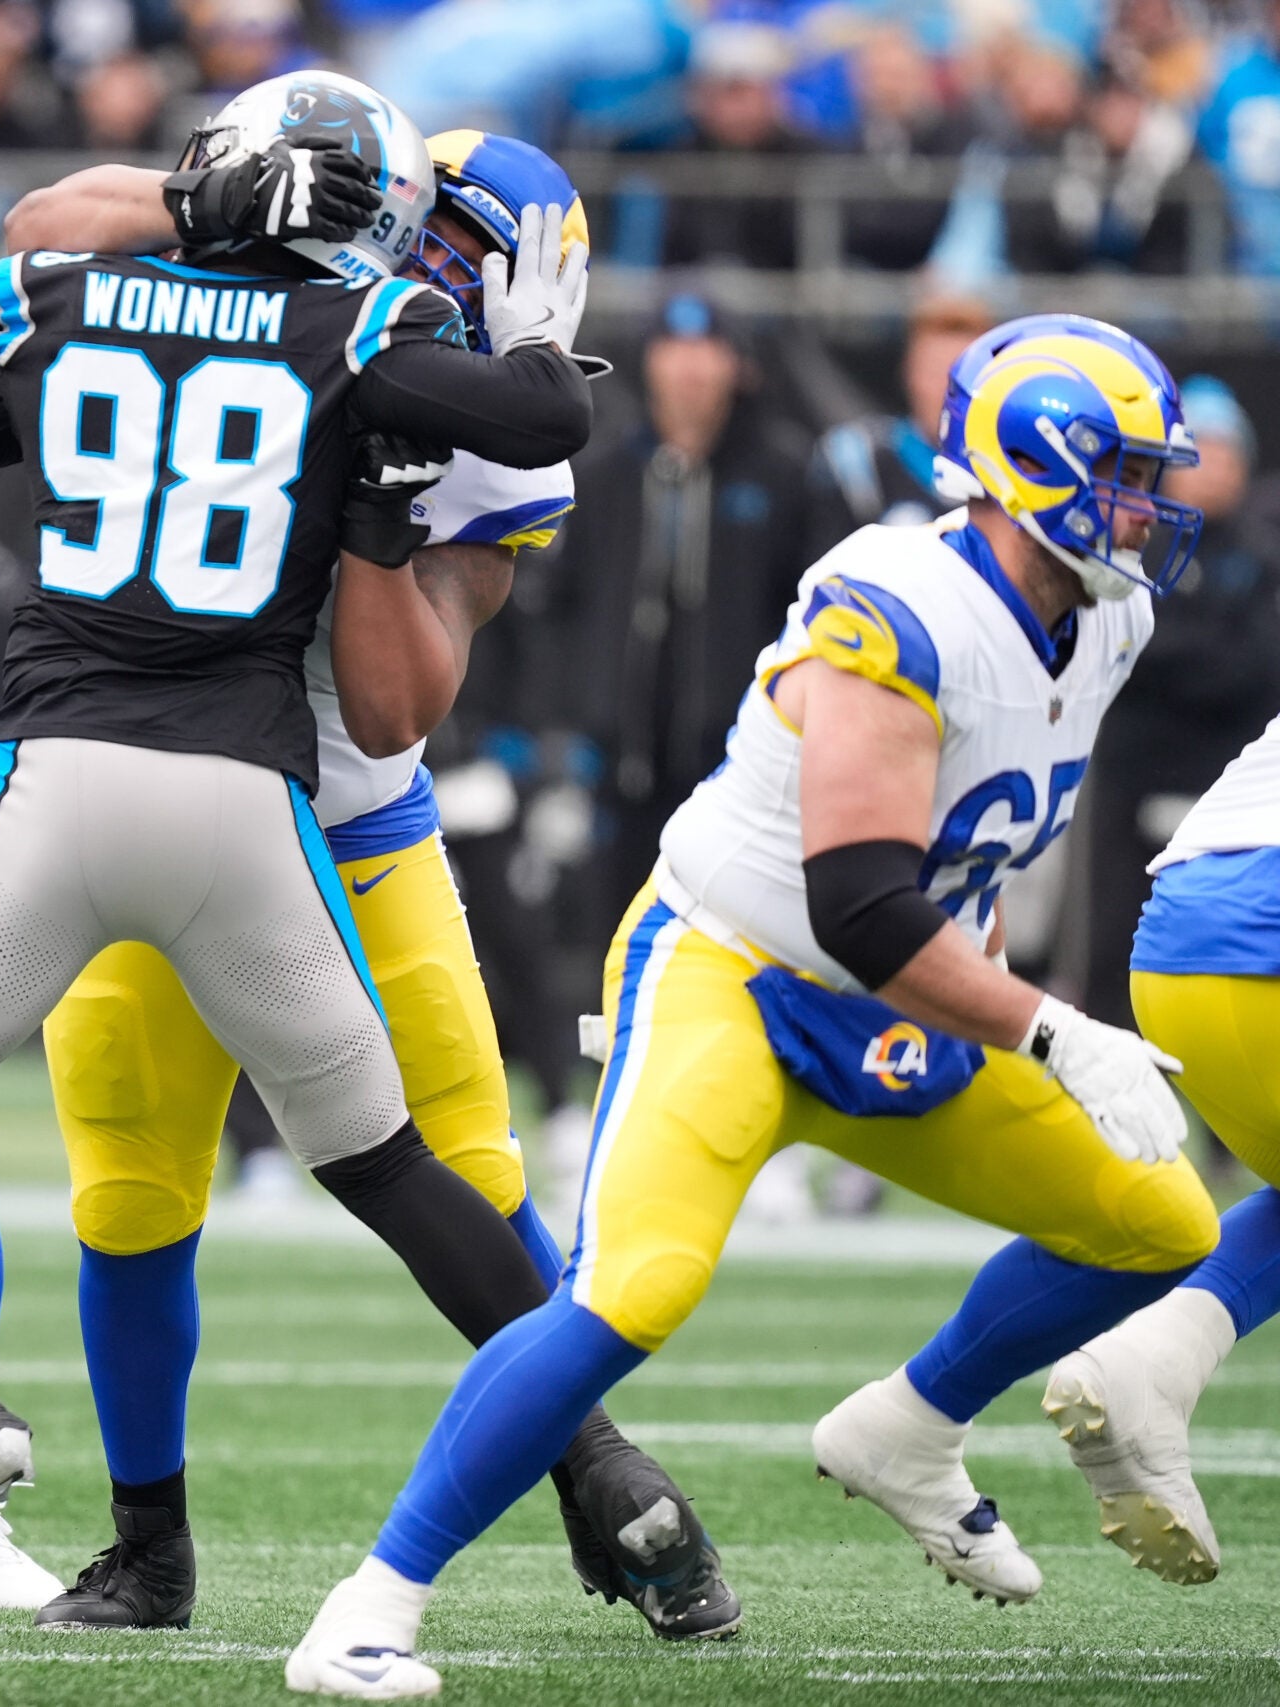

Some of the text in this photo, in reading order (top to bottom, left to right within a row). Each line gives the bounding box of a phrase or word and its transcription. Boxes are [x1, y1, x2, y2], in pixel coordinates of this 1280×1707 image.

[372, 211, 413, 255] 98
[470, 189, 516, 231] RAMS
[83, 270, 289, 345] WONNUM
[39, 341, 313, 619] 98
[861, 1022, 927, 1078] LA
